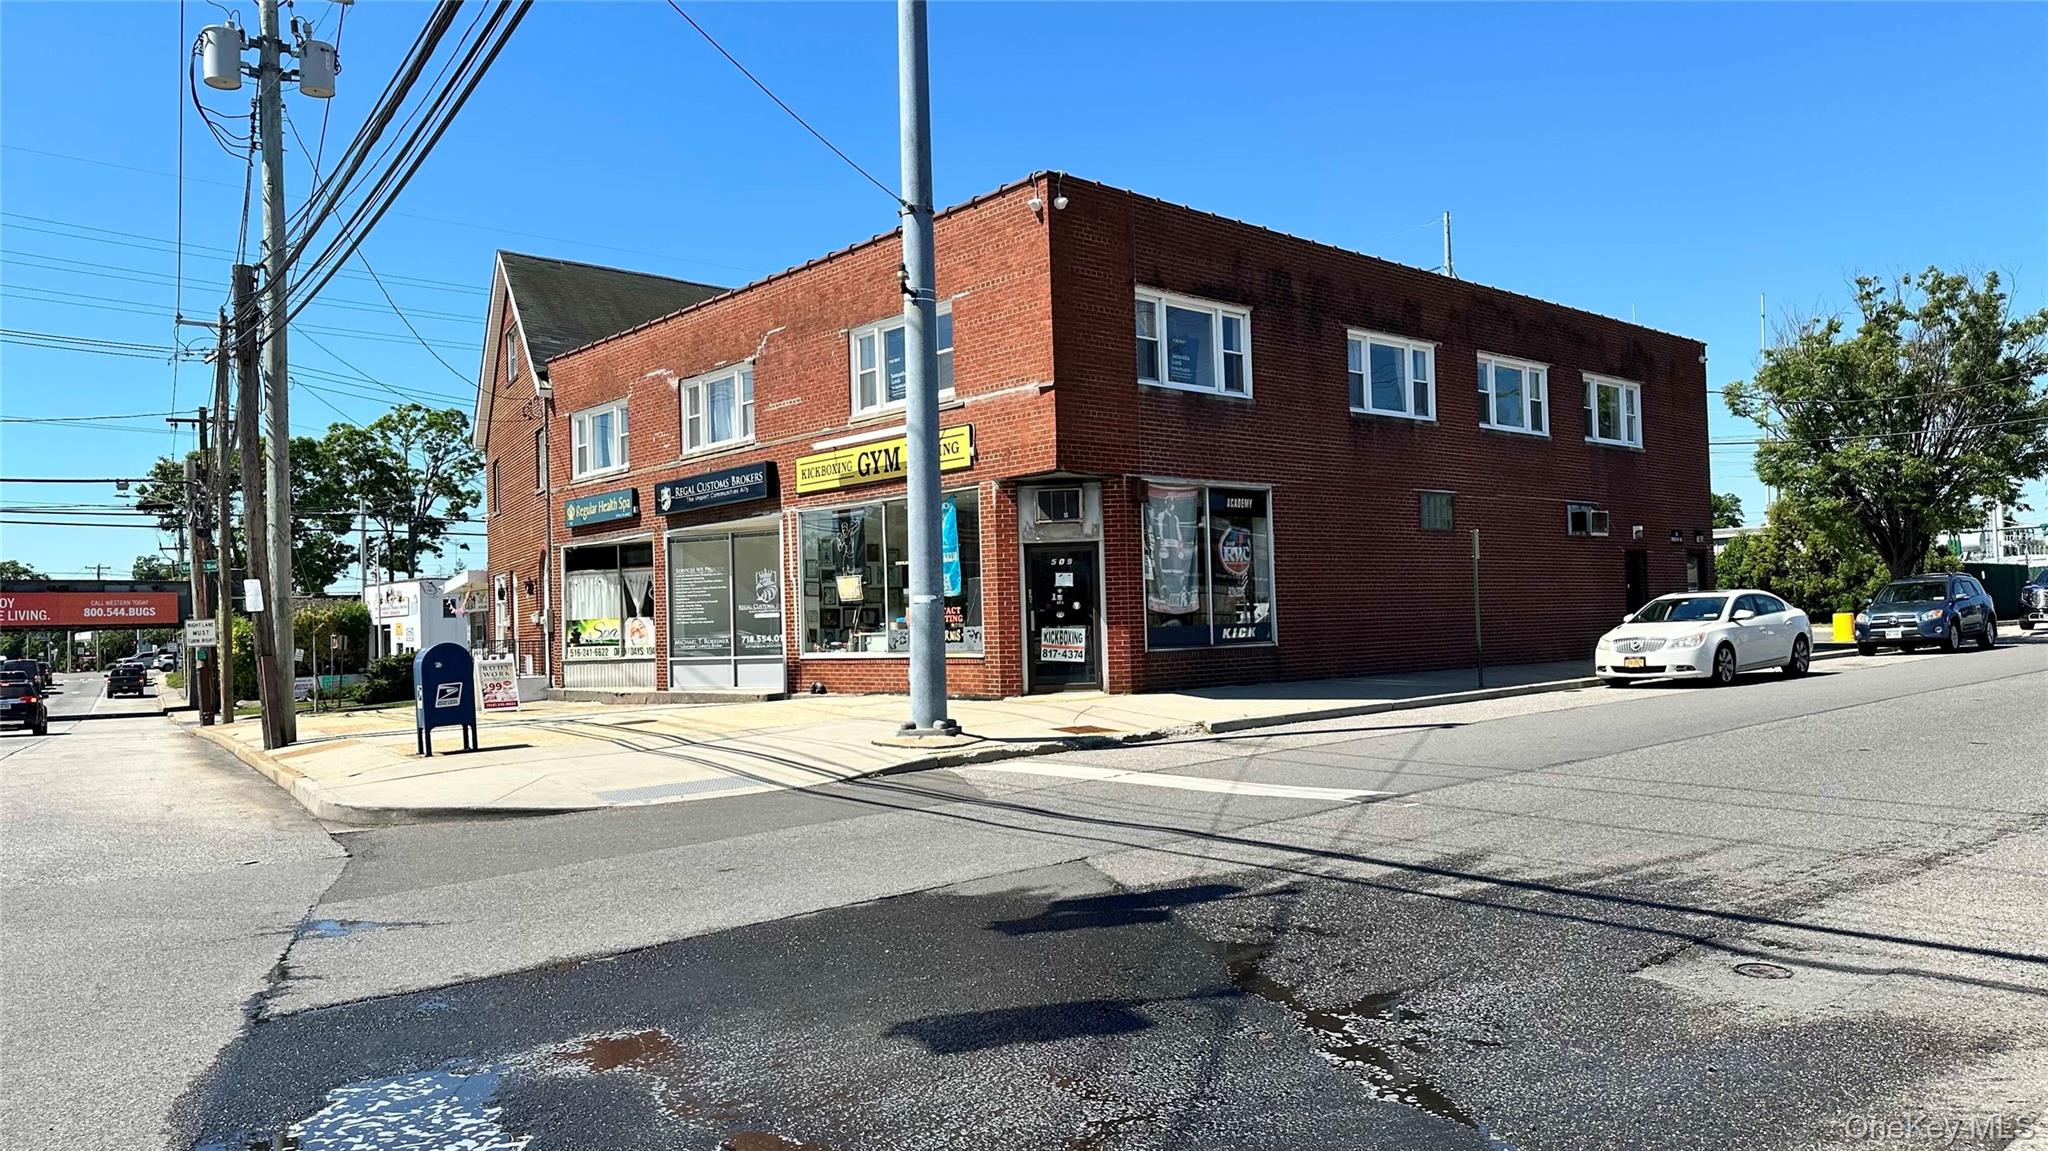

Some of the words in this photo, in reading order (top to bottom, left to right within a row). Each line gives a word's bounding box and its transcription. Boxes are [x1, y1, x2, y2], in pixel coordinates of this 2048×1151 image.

[801, 461, 853, 480] KICKBOXING
[858, 446, 901, 477] GYM
[675, 485, 695, 497] REGAL
[696, 478, 730, 493] CUSTOMS
[731, 471, 764, 486] BROKERS
[576, 502, 598, 521] Regular
[598, 497, 618, 513] Health
[618, 496, 631, 512] Spa
[1226, 497, 1253, 509] ACADEMY
[1050, 558, 1073, 566] 509
[8, 609, 51, 621] LIVING.
[83, 607, 156, 617] 800.544.BUGS
[594, 621, 618, 640] Spa
[1043, 629, 1083, 645] KICKBOXING
[1222, 626, 1257, 639] KICK
[1042, 649, 1084, 659] 817-4374
